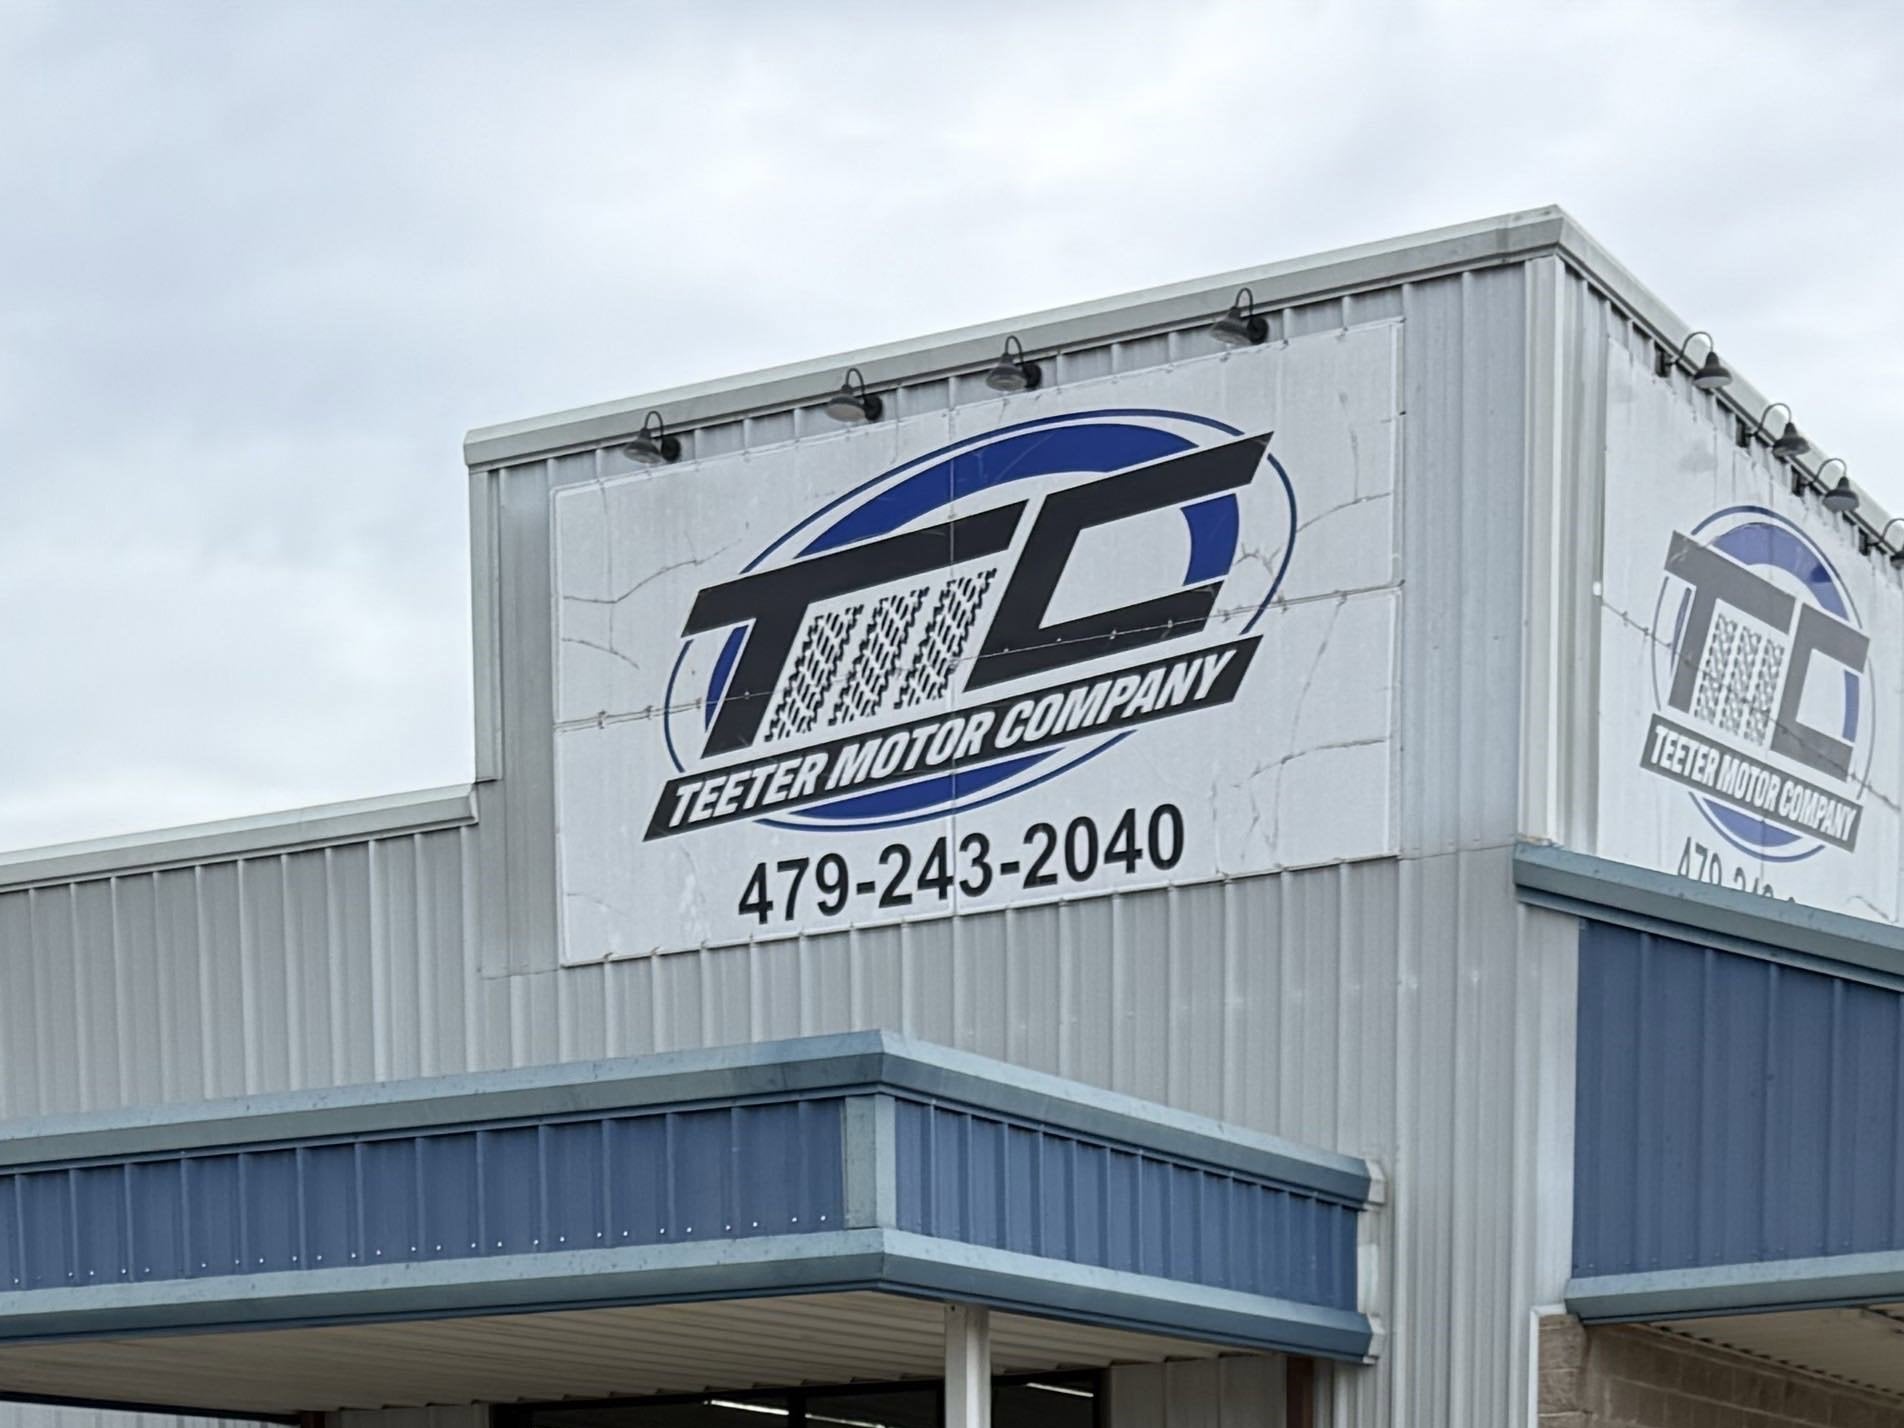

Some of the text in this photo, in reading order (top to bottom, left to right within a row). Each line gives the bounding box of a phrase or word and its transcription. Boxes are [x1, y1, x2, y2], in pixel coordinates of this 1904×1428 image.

[669, 649, 1238, 828] TEETER MOTOR COMPANY
[1650, 725, 1857, 841] TEETER MOTOR COMPANY
[738, 803, 1184, 925] 479-243-2040
